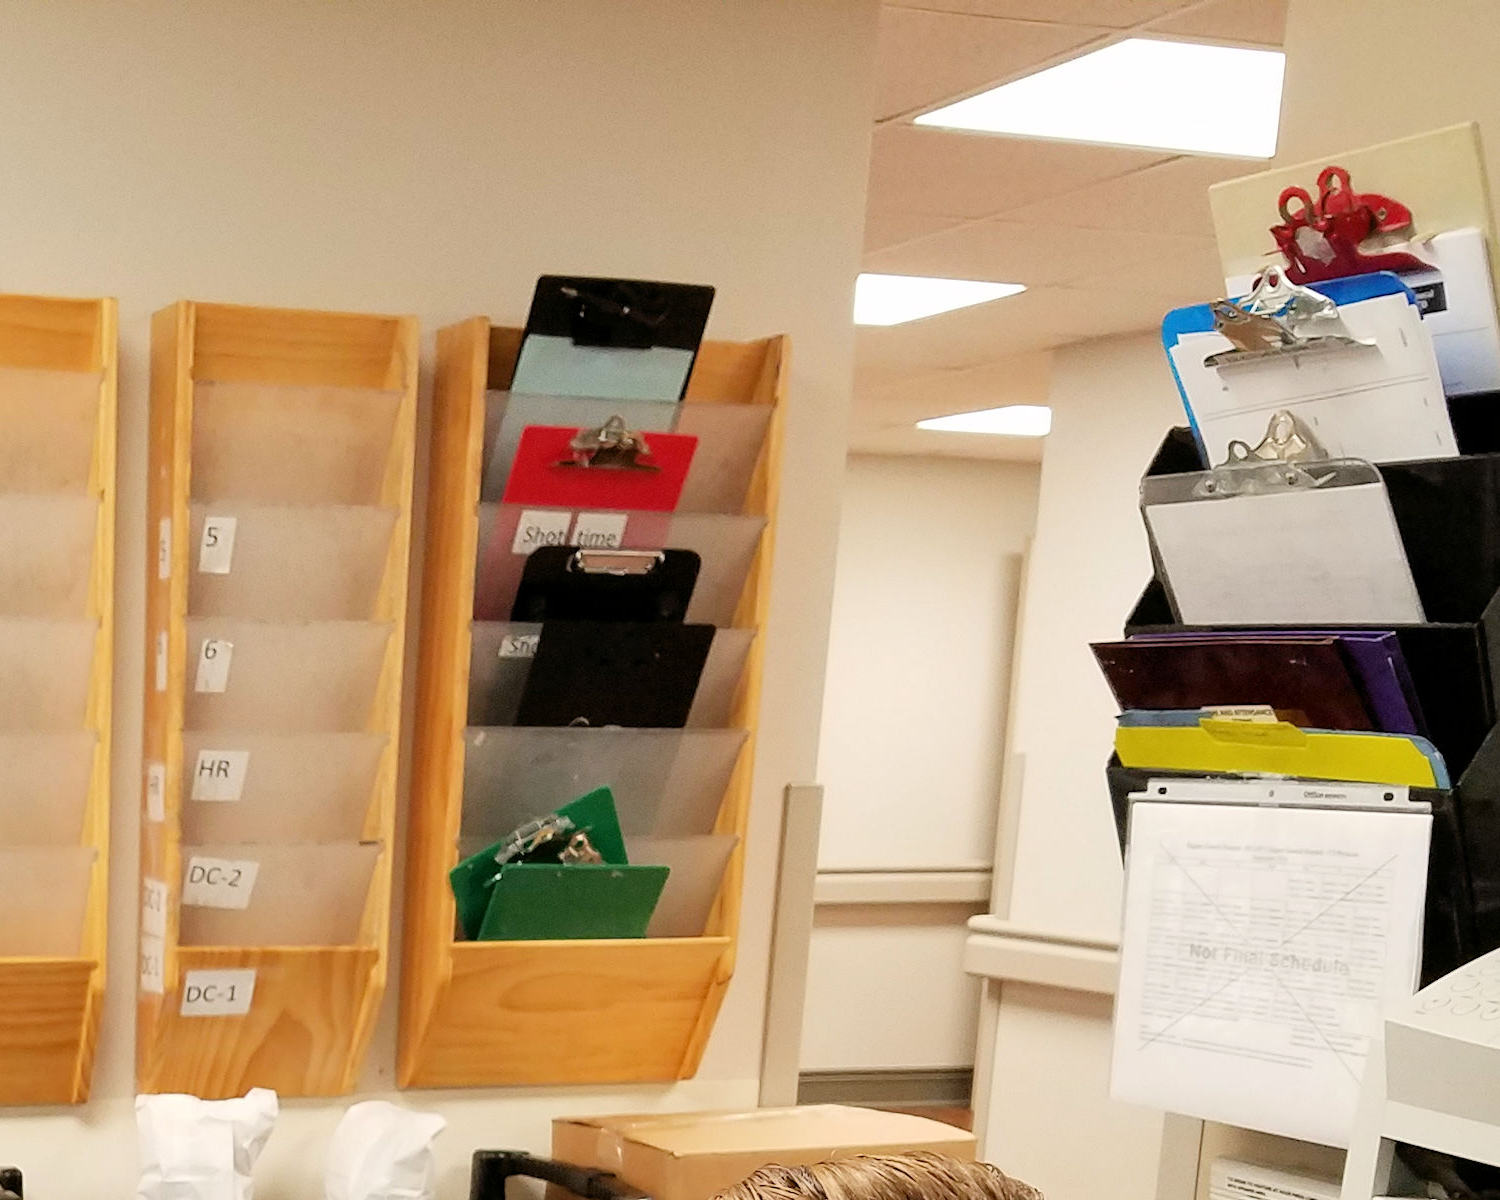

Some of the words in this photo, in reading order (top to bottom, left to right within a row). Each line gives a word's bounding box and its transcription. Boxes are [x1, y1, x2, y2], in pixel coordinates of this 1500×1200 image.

[205, 526, 219, 548] 5
[578, 528, 617, 547] time
[204, 640, 218, 660] 6
[198, 759, 230, 779] HR
[188, 864, 243, 888] DC-2
[1269, 951, 1350, 977] Schedule
[185, 984, 238, 1004] DC-1
